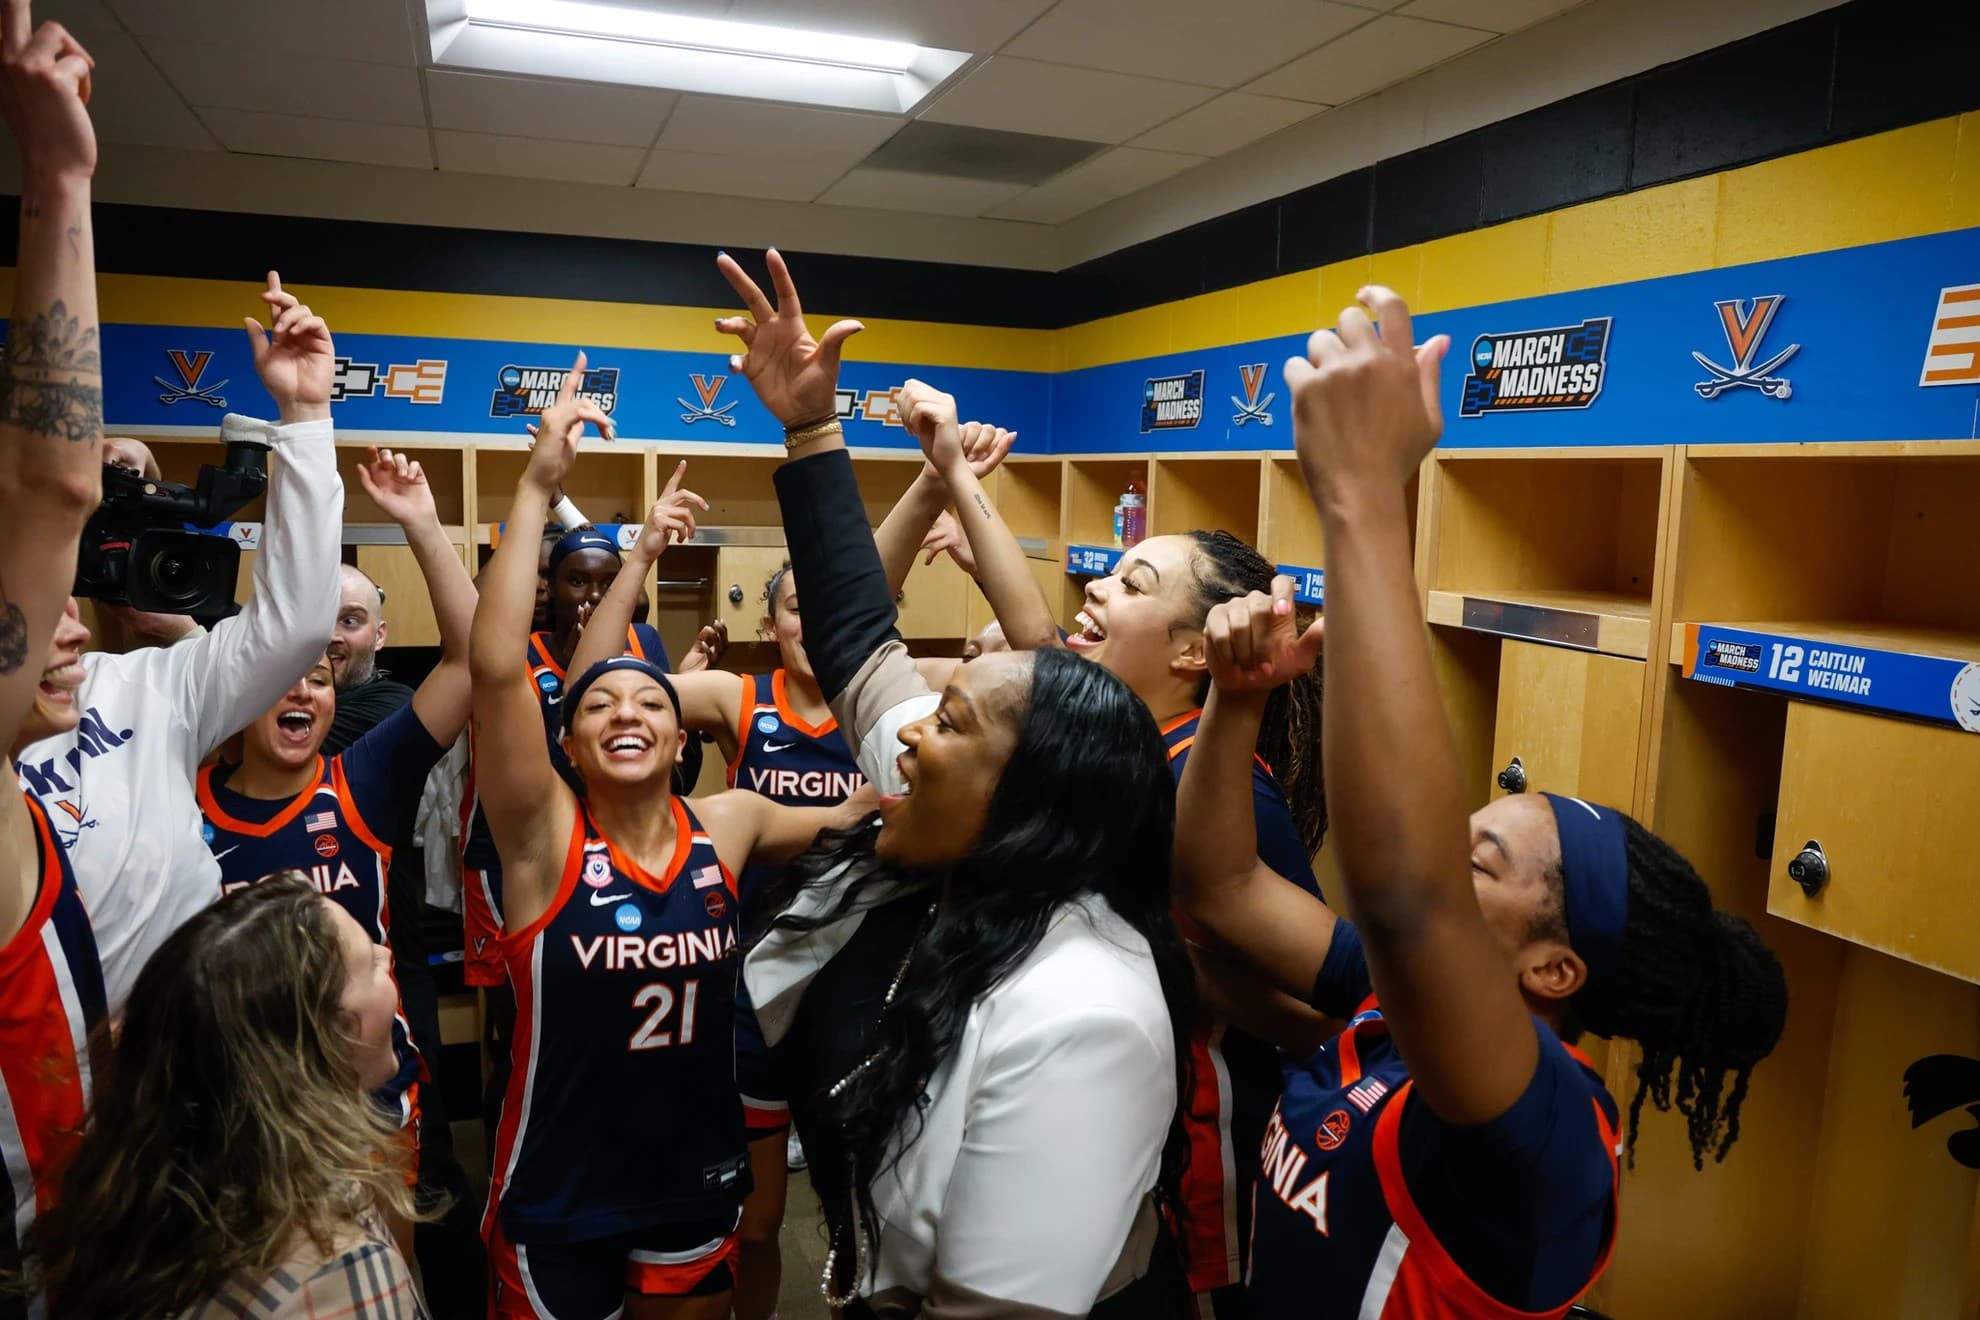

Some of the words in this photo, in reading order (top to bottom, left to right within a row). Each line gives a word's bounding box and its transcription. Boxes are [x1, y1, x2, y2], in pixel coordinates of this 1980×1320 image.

[1492, 334, 1565, 368] MARCH
[1153, 379, 1185, 402] MARCH
[1498, 363, 1600, 397] MADNESS
[1156, 398, 1200, 421] MADNESS
[1305, 573, 1312, 597] 1
[1717, 643, 1746, 656] MARCH
[1719, 653, 1759, 669] MADNESS
[1809, 650, 1866, 674] CAITLIN
[1769, 643, 1804, 683] 12
[1807, 670, 1872, 696] WEIMAR
[748, 766, 864, 798] VIRGINI
[628, 978, 700, 1051] 21
